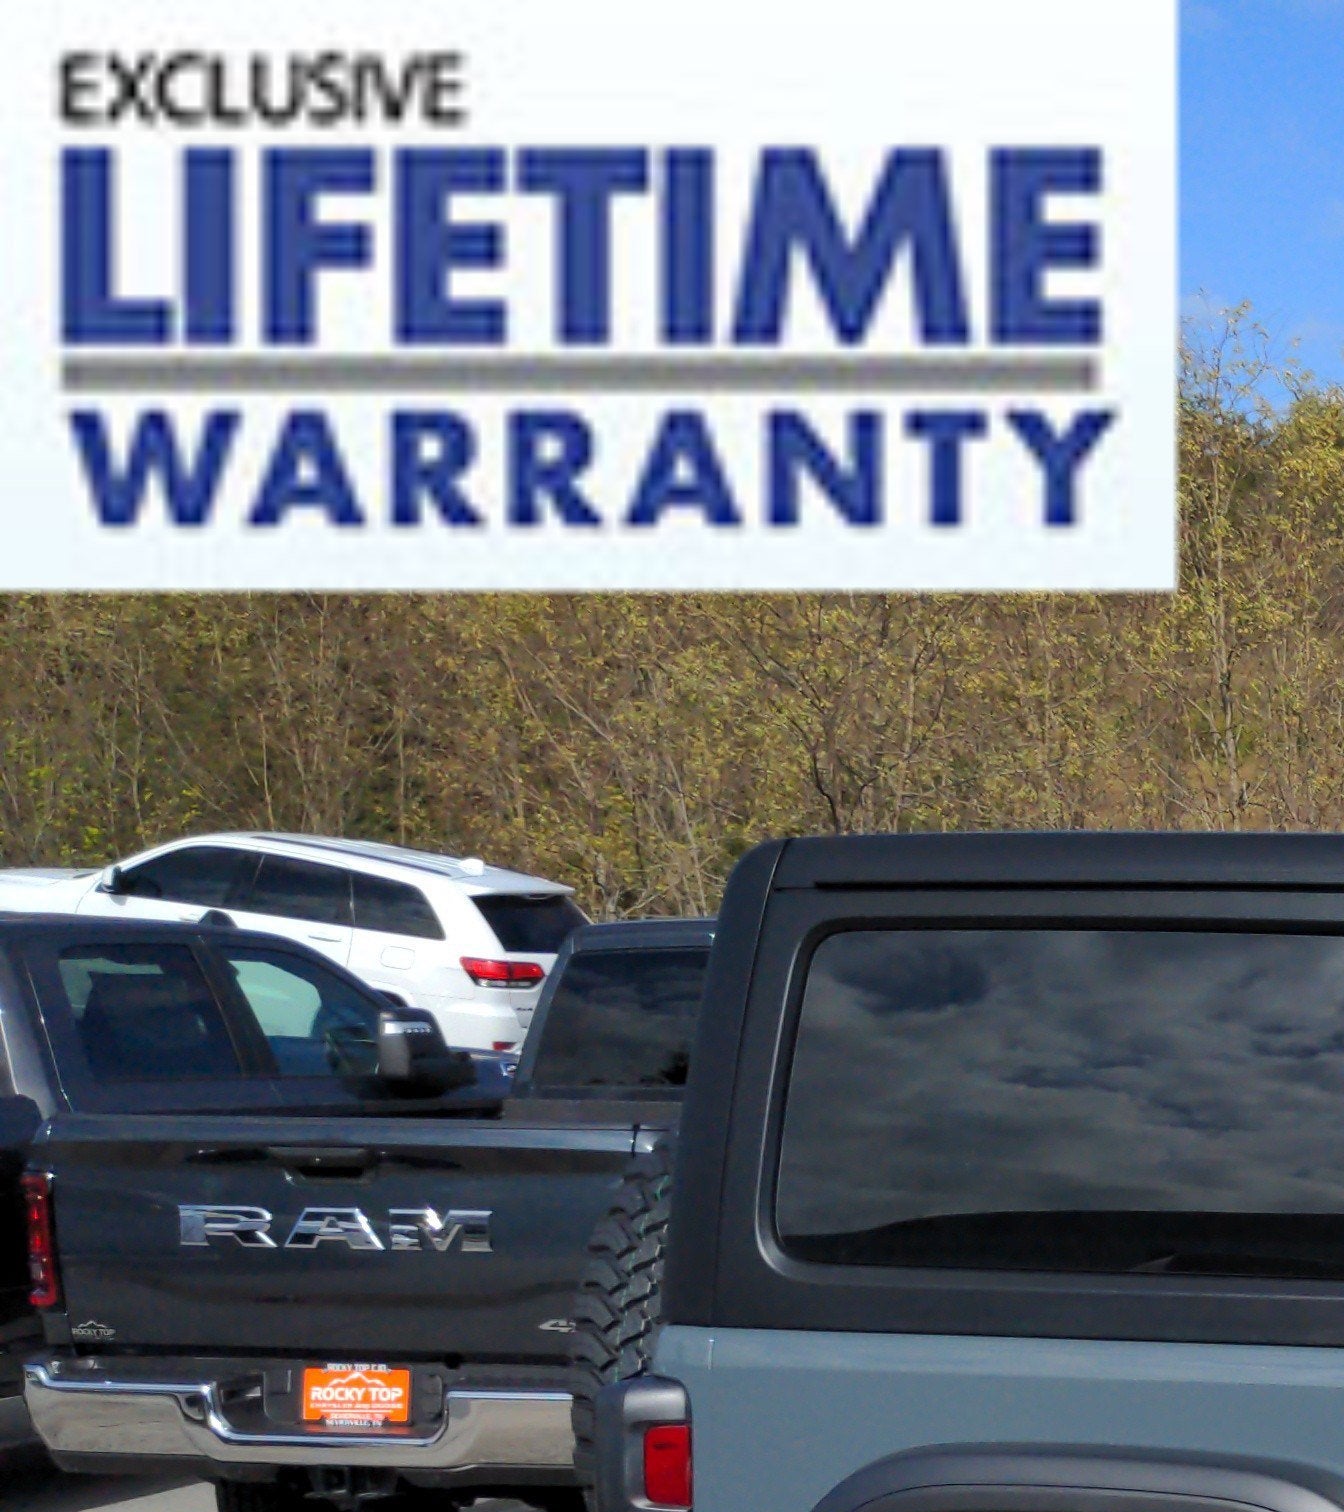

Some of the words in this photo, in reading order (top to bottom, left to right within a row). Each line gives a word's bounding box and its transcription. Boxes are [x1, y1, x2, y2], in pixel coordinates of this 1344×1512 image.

[177, 1204, 493, 1252] RAM
[311, 1386, 366, 1401] ROCKY
[368, 1387, 403, 1401] TOP
